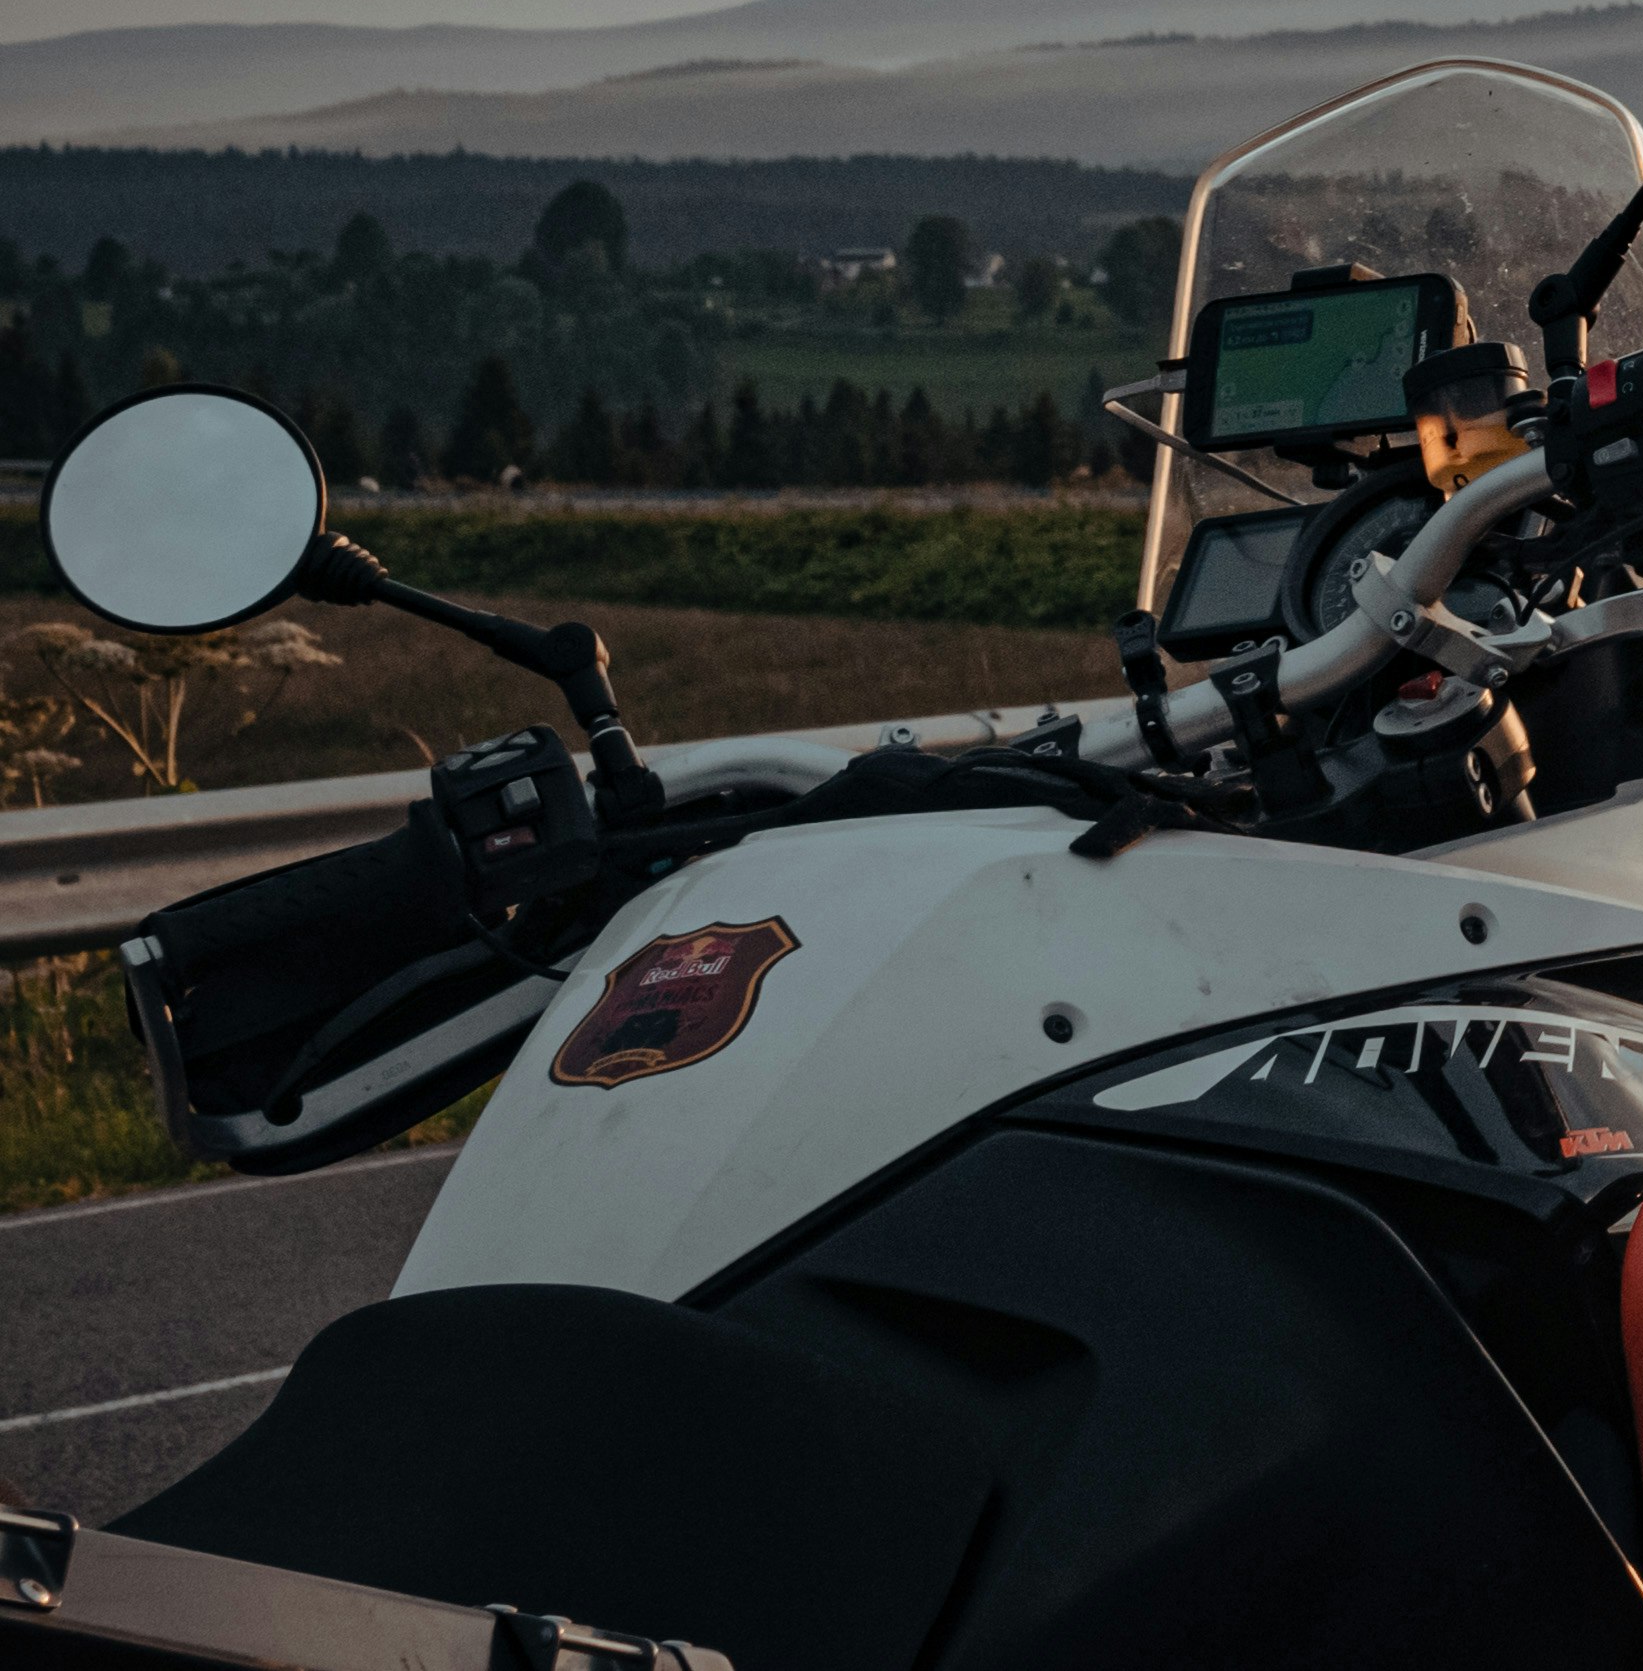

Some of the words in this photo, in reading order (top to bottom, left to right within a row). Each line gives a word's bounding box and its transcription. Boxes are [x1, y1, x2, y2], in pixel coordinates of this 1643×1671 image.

[639, 961, 683, 986] Red
[682, 955, 731, 978] Bull
[1558, 1126, 1635, 1159] KTM
